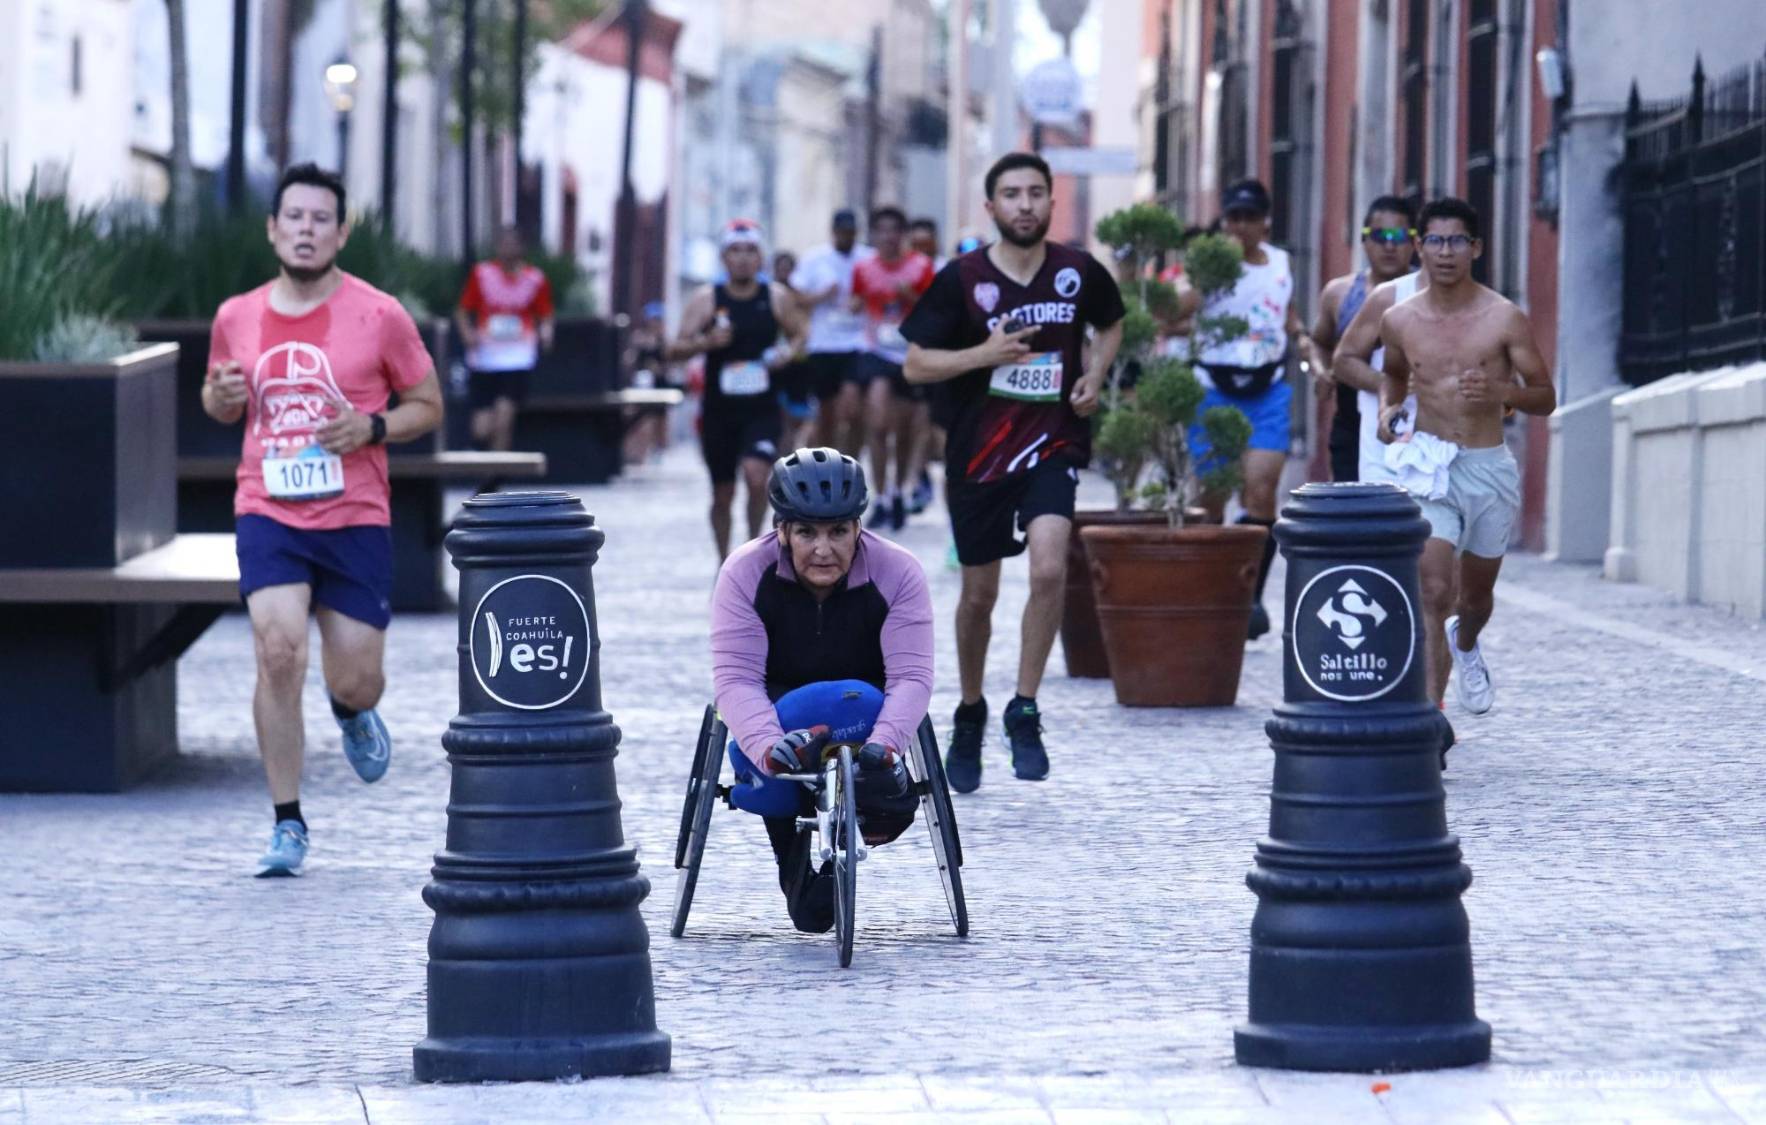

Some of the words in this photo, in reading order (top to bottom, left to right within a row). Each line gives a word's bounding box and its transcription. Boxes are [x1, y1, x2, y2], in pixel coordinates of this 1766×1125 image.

[987, 302, 1076, 332] TORES
[1006, 368, 1051, 390] 4888
[281, 461, 328, 488] 1071
[508, 616, 556, 626] FUERTE
[510, 636, 573, 679] es!
[1320, 653, 1388, 670] Saltillo
